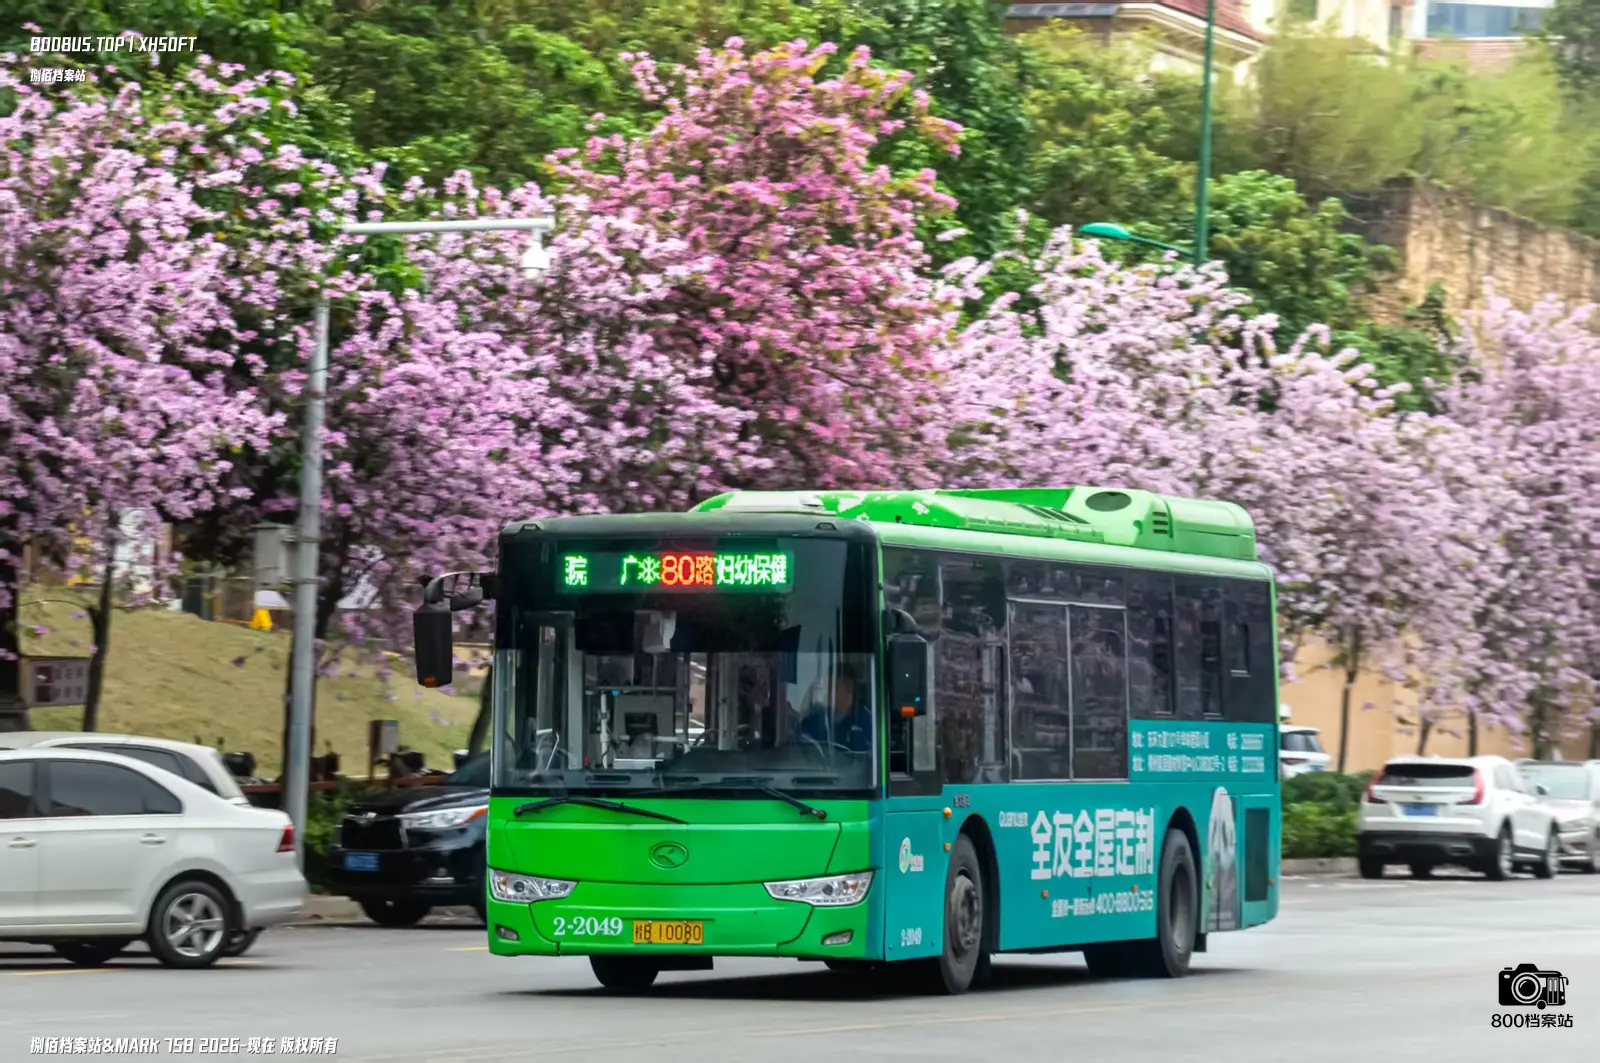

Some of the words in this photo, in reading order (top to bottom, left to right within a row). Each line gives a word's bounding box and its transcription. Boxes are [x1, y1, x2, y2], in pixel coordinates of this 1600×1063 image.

[1030, 807, 1155, 880] 全友全屋定制
[553, 916, 623, 936] 2-2049
